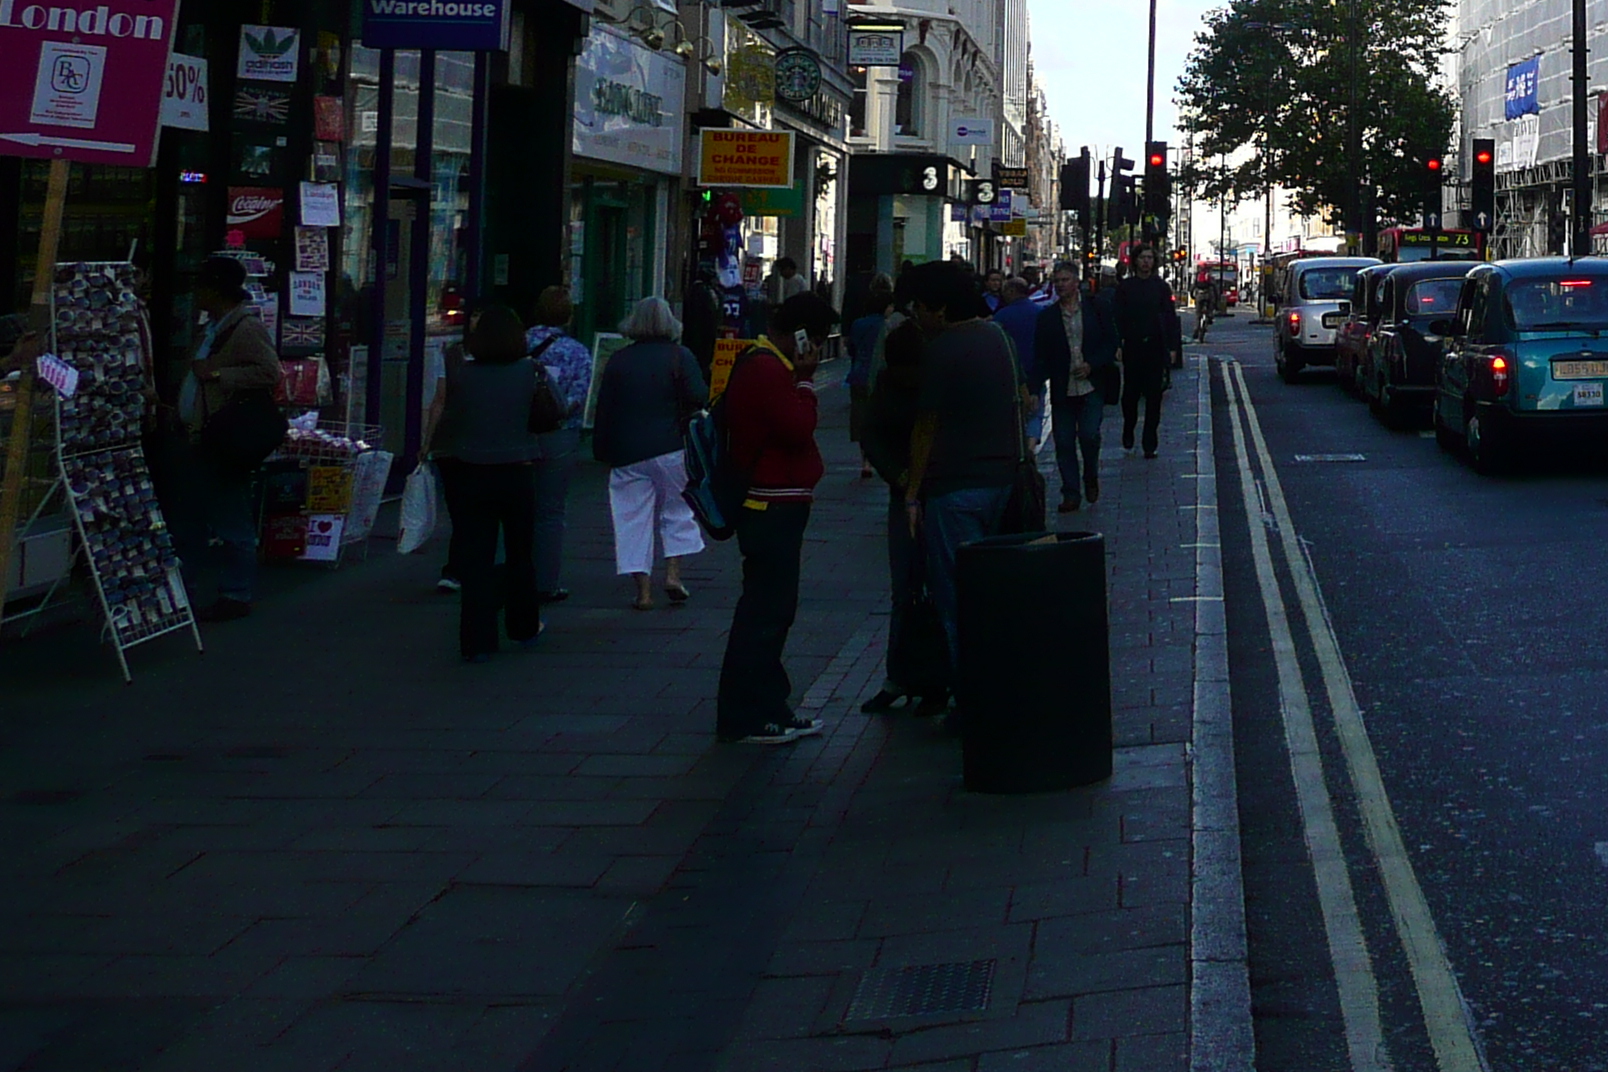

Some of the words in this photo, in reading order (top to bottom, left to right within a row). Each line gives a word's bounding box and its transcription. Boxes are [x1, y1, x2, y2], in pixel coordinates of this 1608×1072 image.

[713, 132, 780, 143] BUREAU
[736, 144, 758, 154] DE
[711, 154, 780, 166] CHANGE
[922, 166, 939, 191] 3
[978, 182, 995, 203] 3
[1454, 233, 1470, 245] 73
